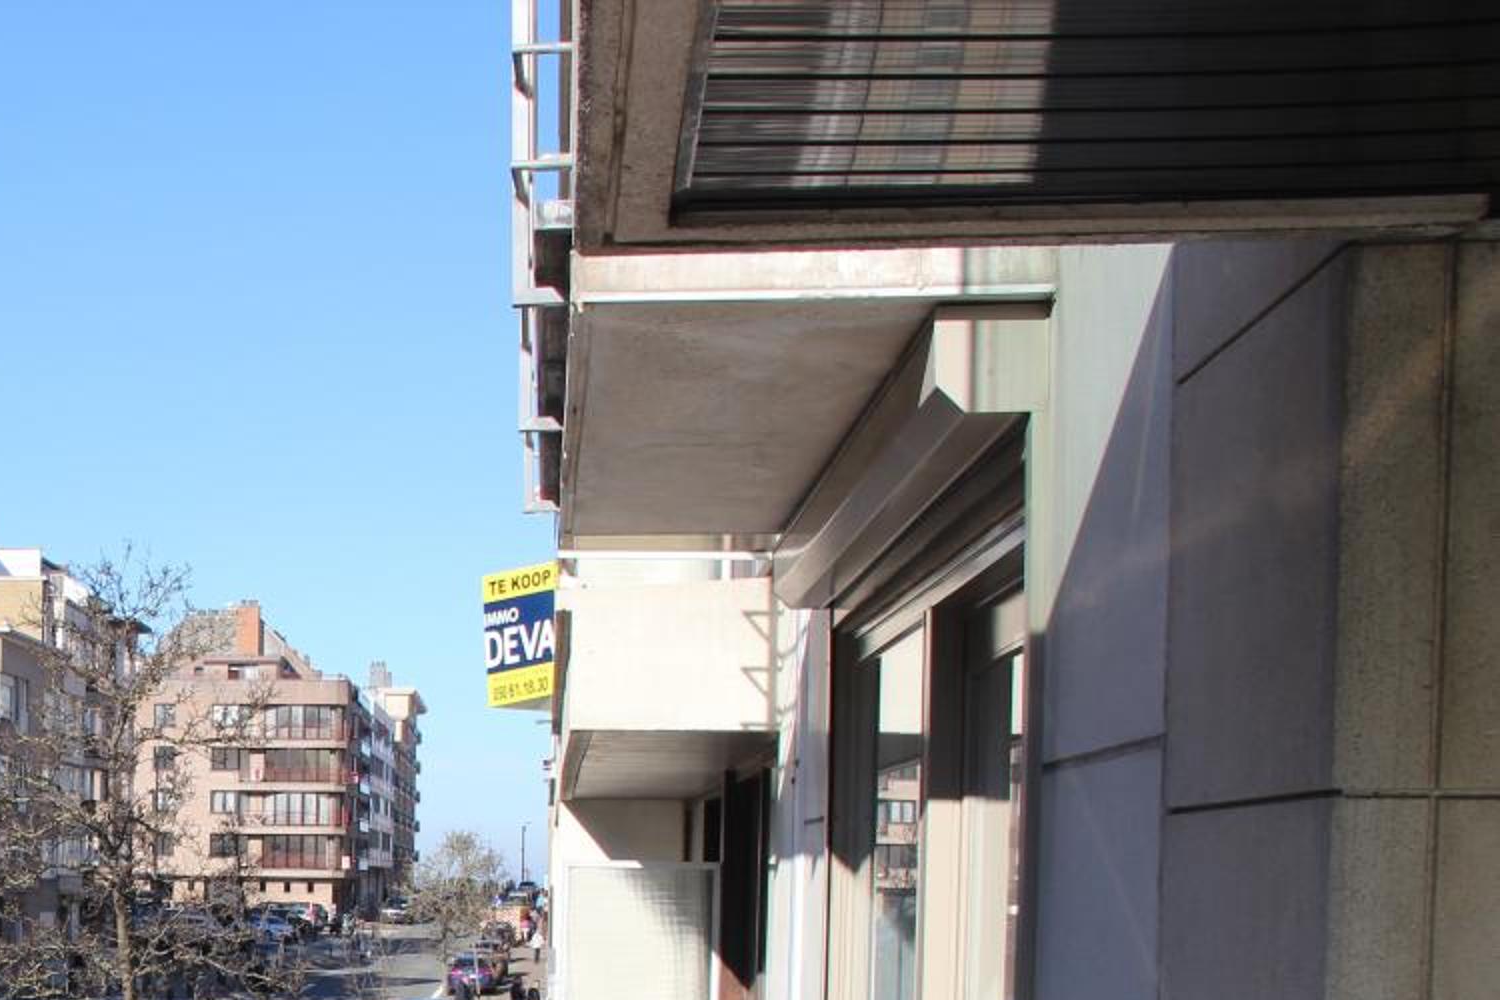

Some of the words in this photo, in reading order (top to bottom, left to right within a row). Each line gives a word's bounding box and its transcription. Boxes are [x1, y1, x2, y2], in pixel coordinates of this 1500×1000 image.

[488, 579, 507, 596] TE
[511, 569, 551, 591] KOOP
[484, 606, 520, 627] IMMO
[484, 618, 555, 669] DEVA
